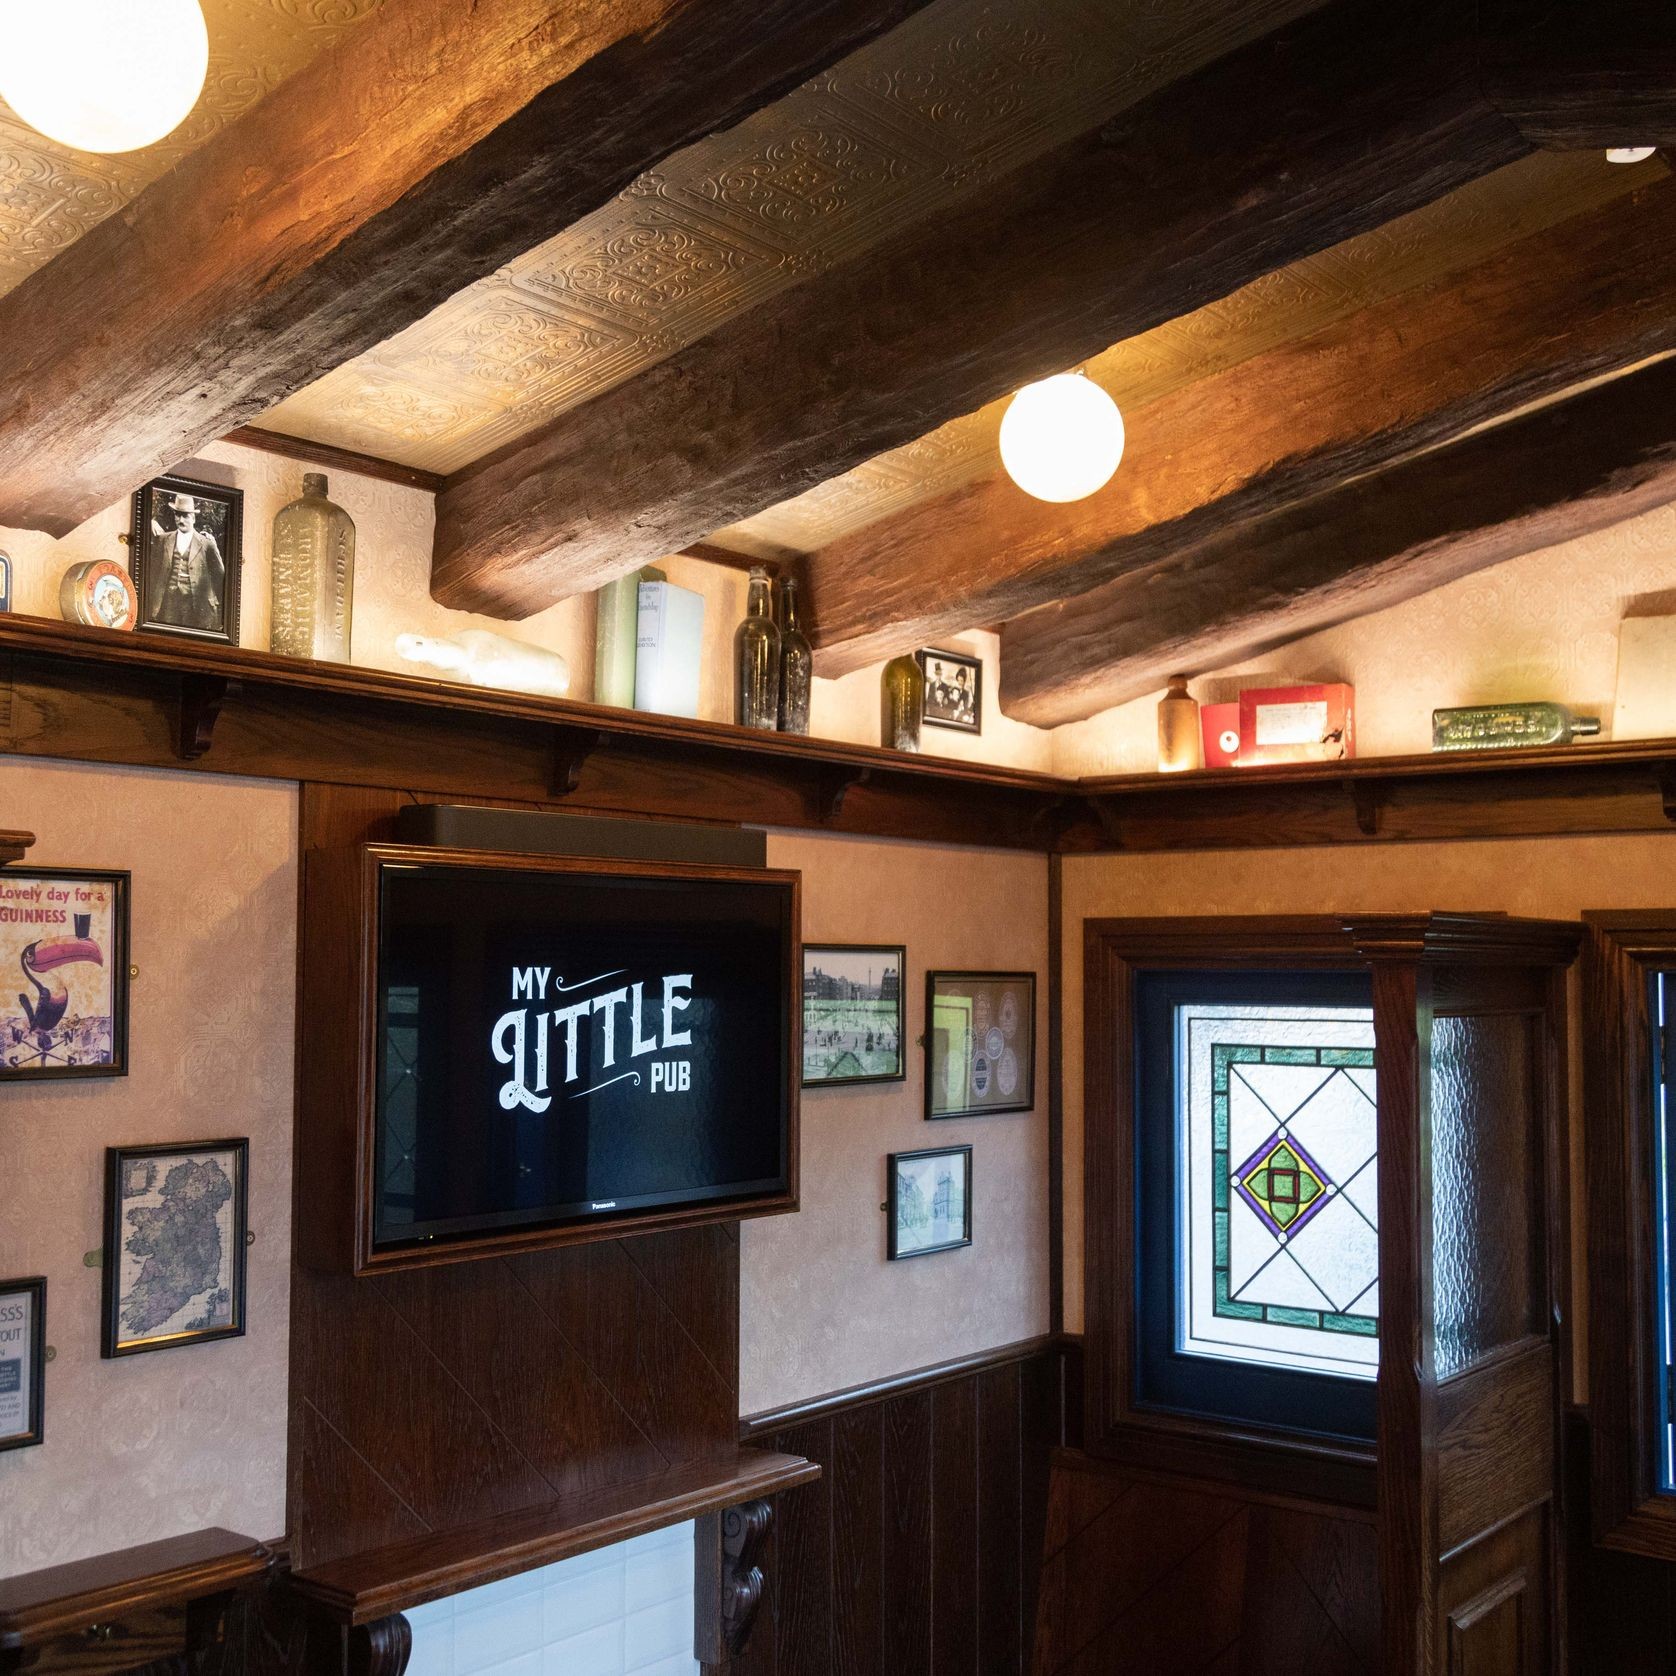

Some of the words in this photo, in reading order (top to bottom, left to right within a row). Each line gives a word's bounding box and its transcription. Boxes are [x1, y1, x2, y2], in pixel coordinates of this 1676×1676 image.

[0, 885, 42, 903] Lovely
[47, 887, 70, 902] day
[75, 887, 93, 902] for
[97, 891, 105, 902] a
[0, 906, 67, 924] GUINNESS
[512, 966, 551, 1000] MY
[491, 974, 693, 1113] LITTLE
[650, 1060, 691, 1093] PUB
